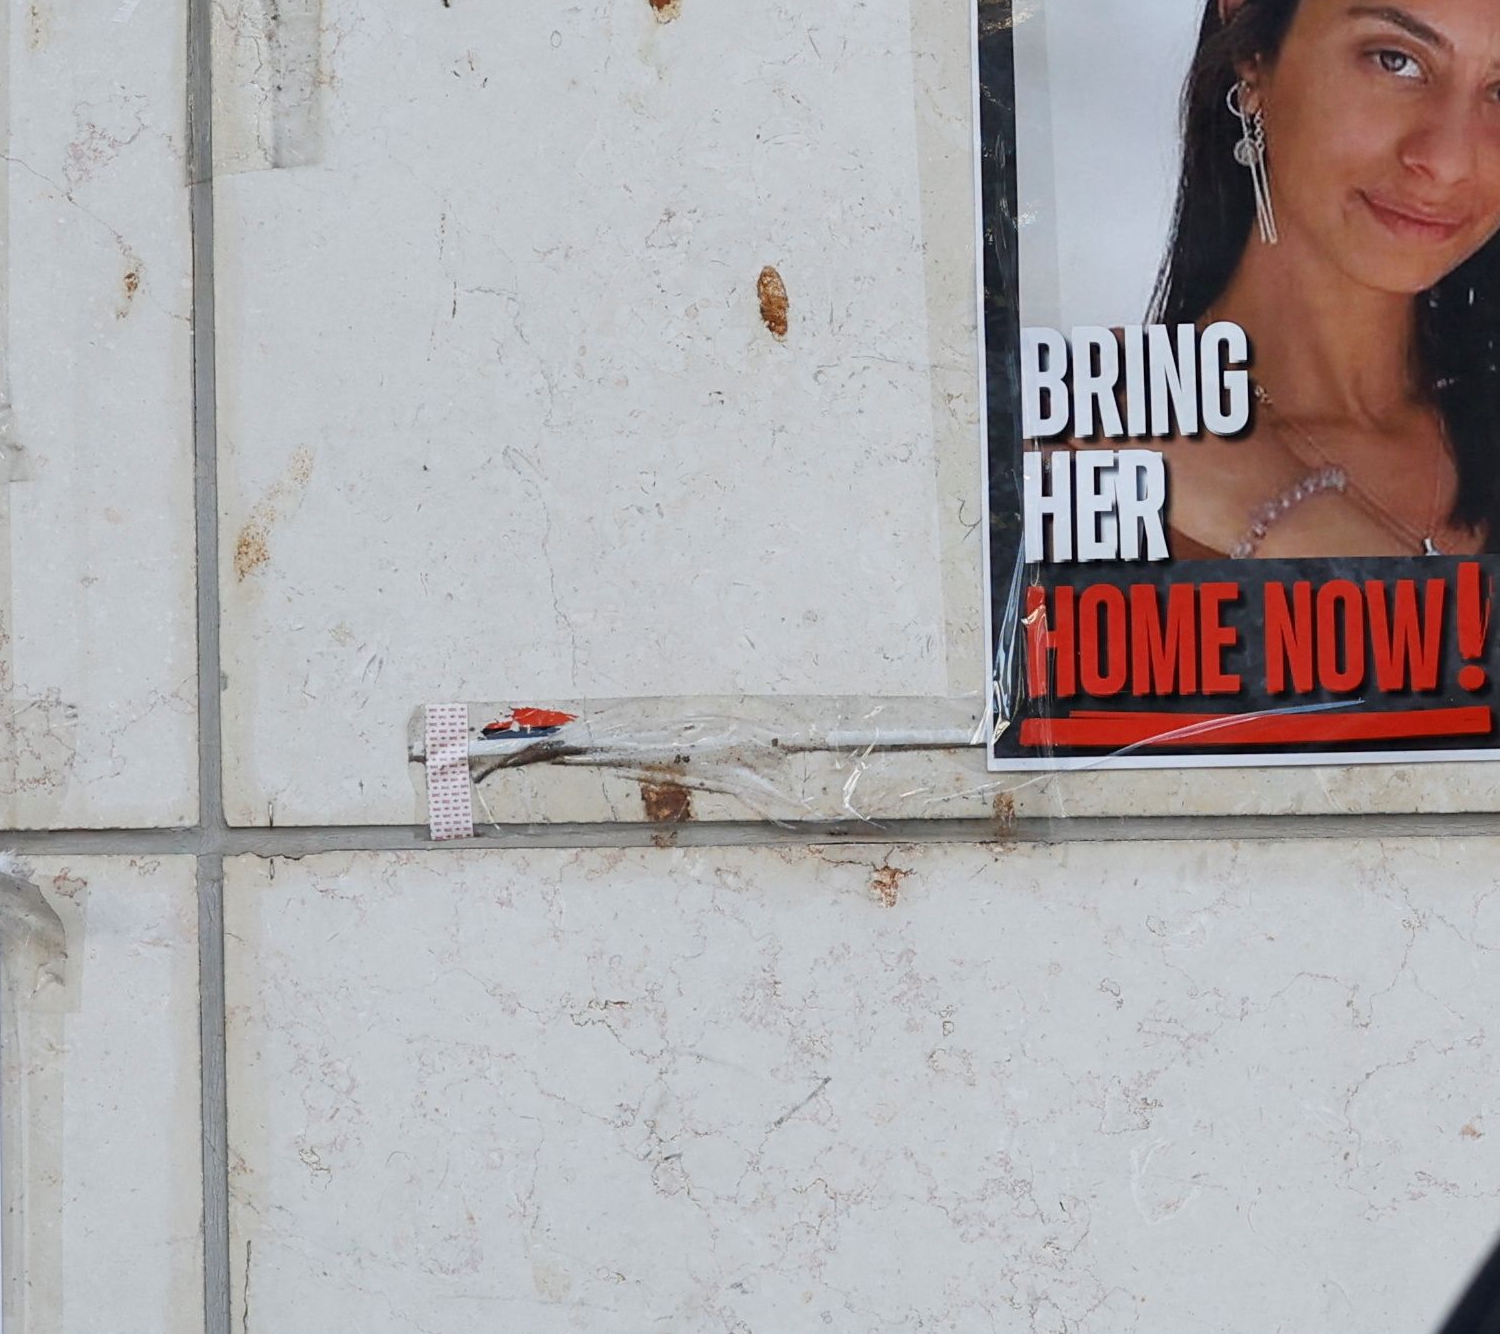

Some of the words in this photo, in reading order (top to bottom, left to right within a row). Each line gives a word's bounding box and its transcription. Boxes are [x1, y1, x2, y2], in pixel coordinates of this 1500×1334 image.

[1022, 320, 1249, 438] BRING
[1023, 449, 1170, 564] HER
[1026, 581, 1242, 698] HOME
[1263, 561, 1491, 694] NOW!
